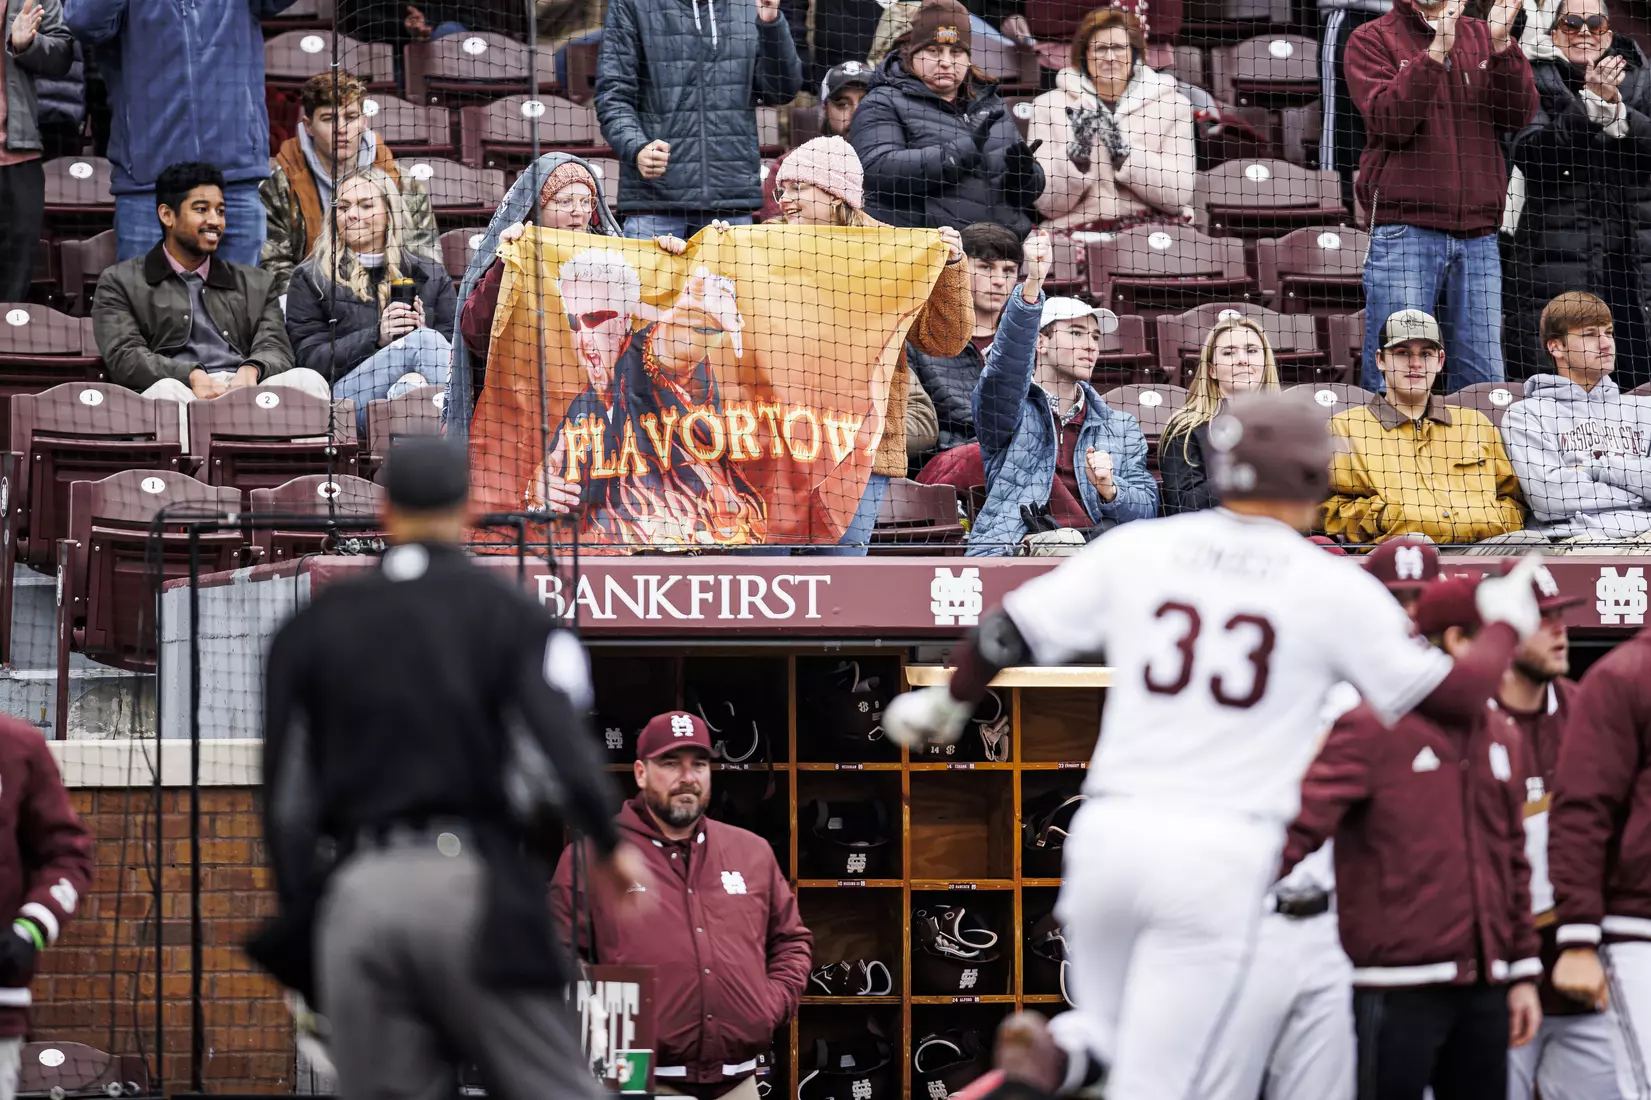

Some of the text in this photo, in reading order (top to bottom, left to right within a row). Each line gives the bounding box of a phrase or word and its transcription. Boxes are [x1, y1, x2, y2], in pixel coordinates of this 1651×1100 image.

[264, 395, 271, 404] 2
[1147, 394, 1153, 403] 7
[1323, 394, 1329, 402] 8
[1497, 392, 1503, 401] 9
[564, 396, 884, 483] FLAVORTOW
[151, 480, 156, 490] 1
[533, 574, 832, 620] BANKFIRST
[1143, 601, 1277, 710] 33
[930, 745, 940, 754] 14
